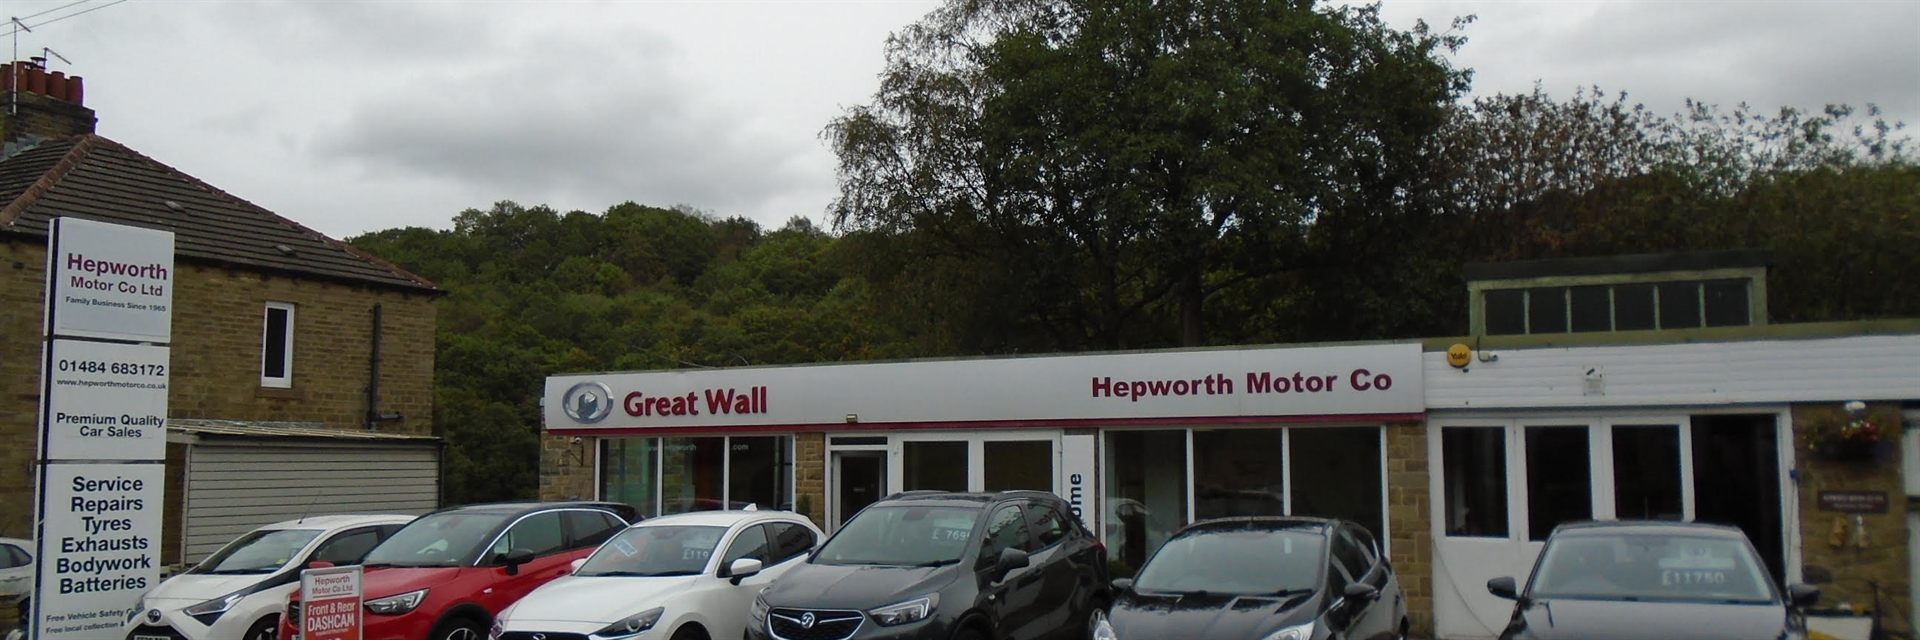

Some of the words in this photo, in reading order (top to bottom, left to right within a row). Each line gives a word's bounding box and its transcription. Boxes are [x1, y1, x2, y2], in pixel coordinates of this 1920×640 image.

[67, 253, 168, 280] Hepworth
[71, 276, 114, 292] Motor
[118, 281, 137, 294] Co
[141, 284, 163, 296] Ltd
[66, 296, 91, 306] Family
[92, 298, 125, 308] Business
[127, 302, 147, 311] Since
[149, 304, 166, 312] 1965
[59, 359, 106, 373] 01484
[111, 362, 165, 376] 683172
[56, 378, 167, 389] www.hepworthmotorco.co.uk
[1092, 373, 1234, 402] Hepworth
[1246, 371, 1338, 394] Motor
[1350, 368, 1392, 391] Co
[623, 391, 699, 417] Great
[705, 386, 768, 414] Wall
[56, 412, 116, 425] Premium
[121, 414, 165, 428] Quality
[80, 426, 104, 437] Car
[107, 426, 142, 438] Sales
[72, 476, 143, 492] Service
[71, 496, 143, 514] Repairs
[82, 516, 131, 535] Tyres
[61, 535, 148, 553] Exhausts
[56, 554, 151, 574] Bodywork
[60, 575, 146, 594] Batteries
[314, 574, 350, 585] Hepworth
[46, 614, 65, 622] Free
[67, 611, 97, 620] Vehicle
[99, 609, 124, 619] Safety
[308, 604, 329, 616] Front
[329, 602, 336, 613] &
[337, 601, 356, 613] Rear
[46, 626, 62, 634] Free
[64, 624, 82, 633] local
[83, 621, 118, 631] collection
[307, 613, 355, 632] DASHCAM
